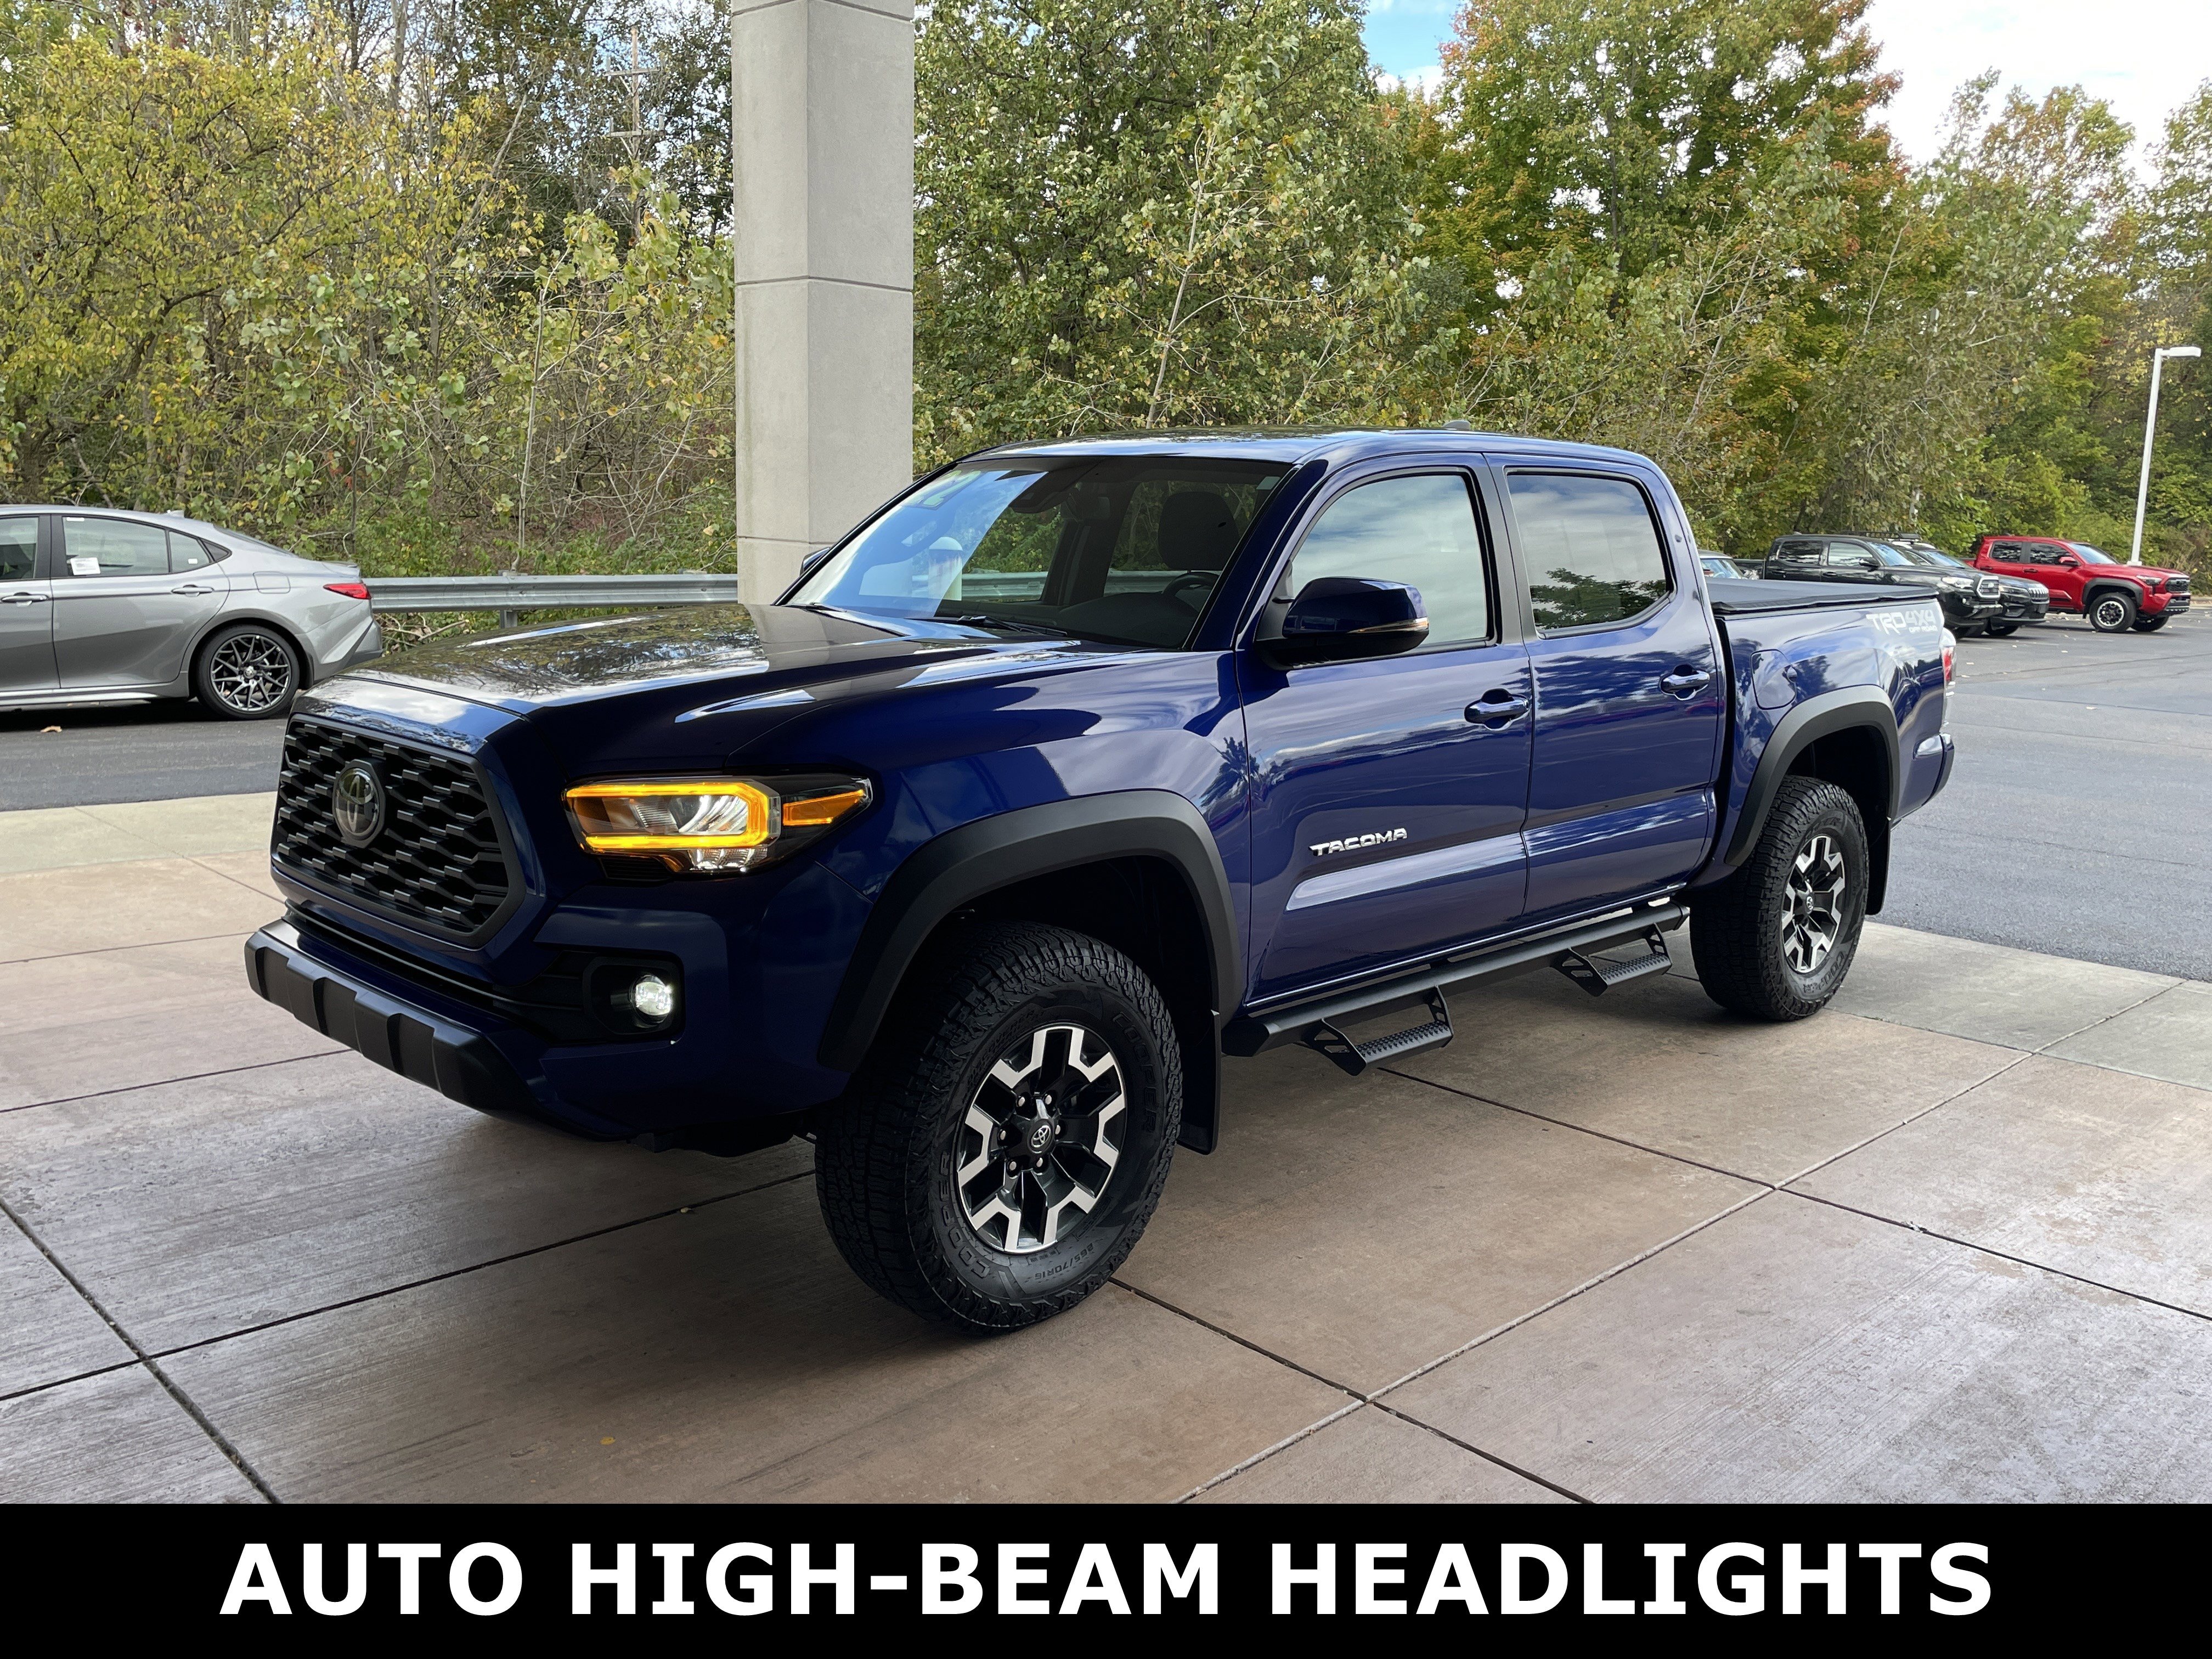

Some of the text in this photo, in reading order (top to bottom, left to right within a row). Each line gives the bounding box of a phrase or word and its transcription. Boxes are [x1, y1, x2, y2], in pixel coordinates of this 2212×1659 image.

[1865, 612, 1906, 635] TRD
[1309, 828, 1407, 856] TACOMA
[1112, 1011, 1159, 1132] COOPER
[939, 1151, 990, 1279] COOPER
[1034, 1242, 1094, 1280] 265/70R16
